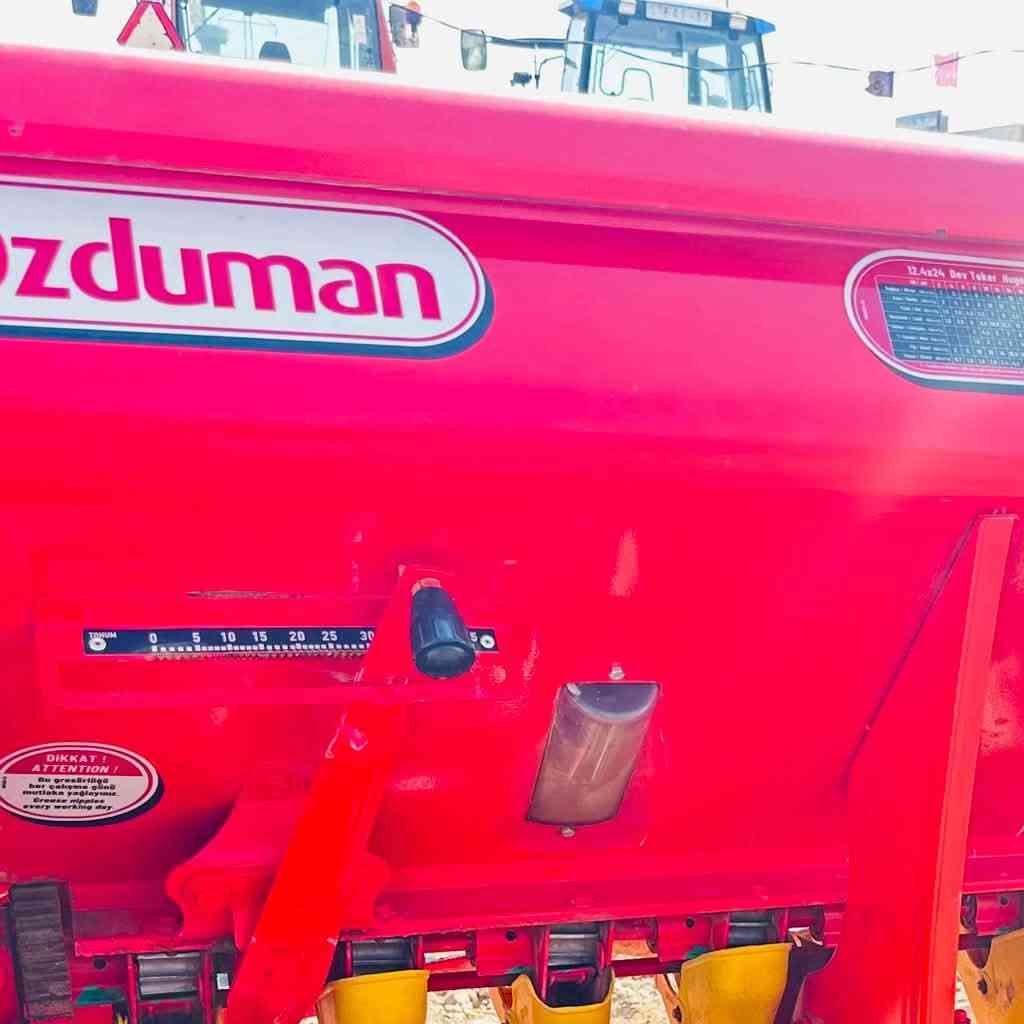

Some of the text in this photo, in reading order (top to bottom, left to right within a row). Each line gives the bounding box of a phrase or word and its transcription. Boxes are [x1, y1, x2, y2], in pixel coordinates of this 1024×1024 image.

[0, 217, 442, 320] zduman
[150, 632, 158, 644] 0
[192, 632, 200, 643] 5
[220, 631, 236, 643] 10
[252, 631, 267, 643] 15
[289, 631, 305, 642] 20
[321, 631, 338, 642] 25
[360, 631, 375, 641] 30
[32, 764, 109, 773] ATTENTION
